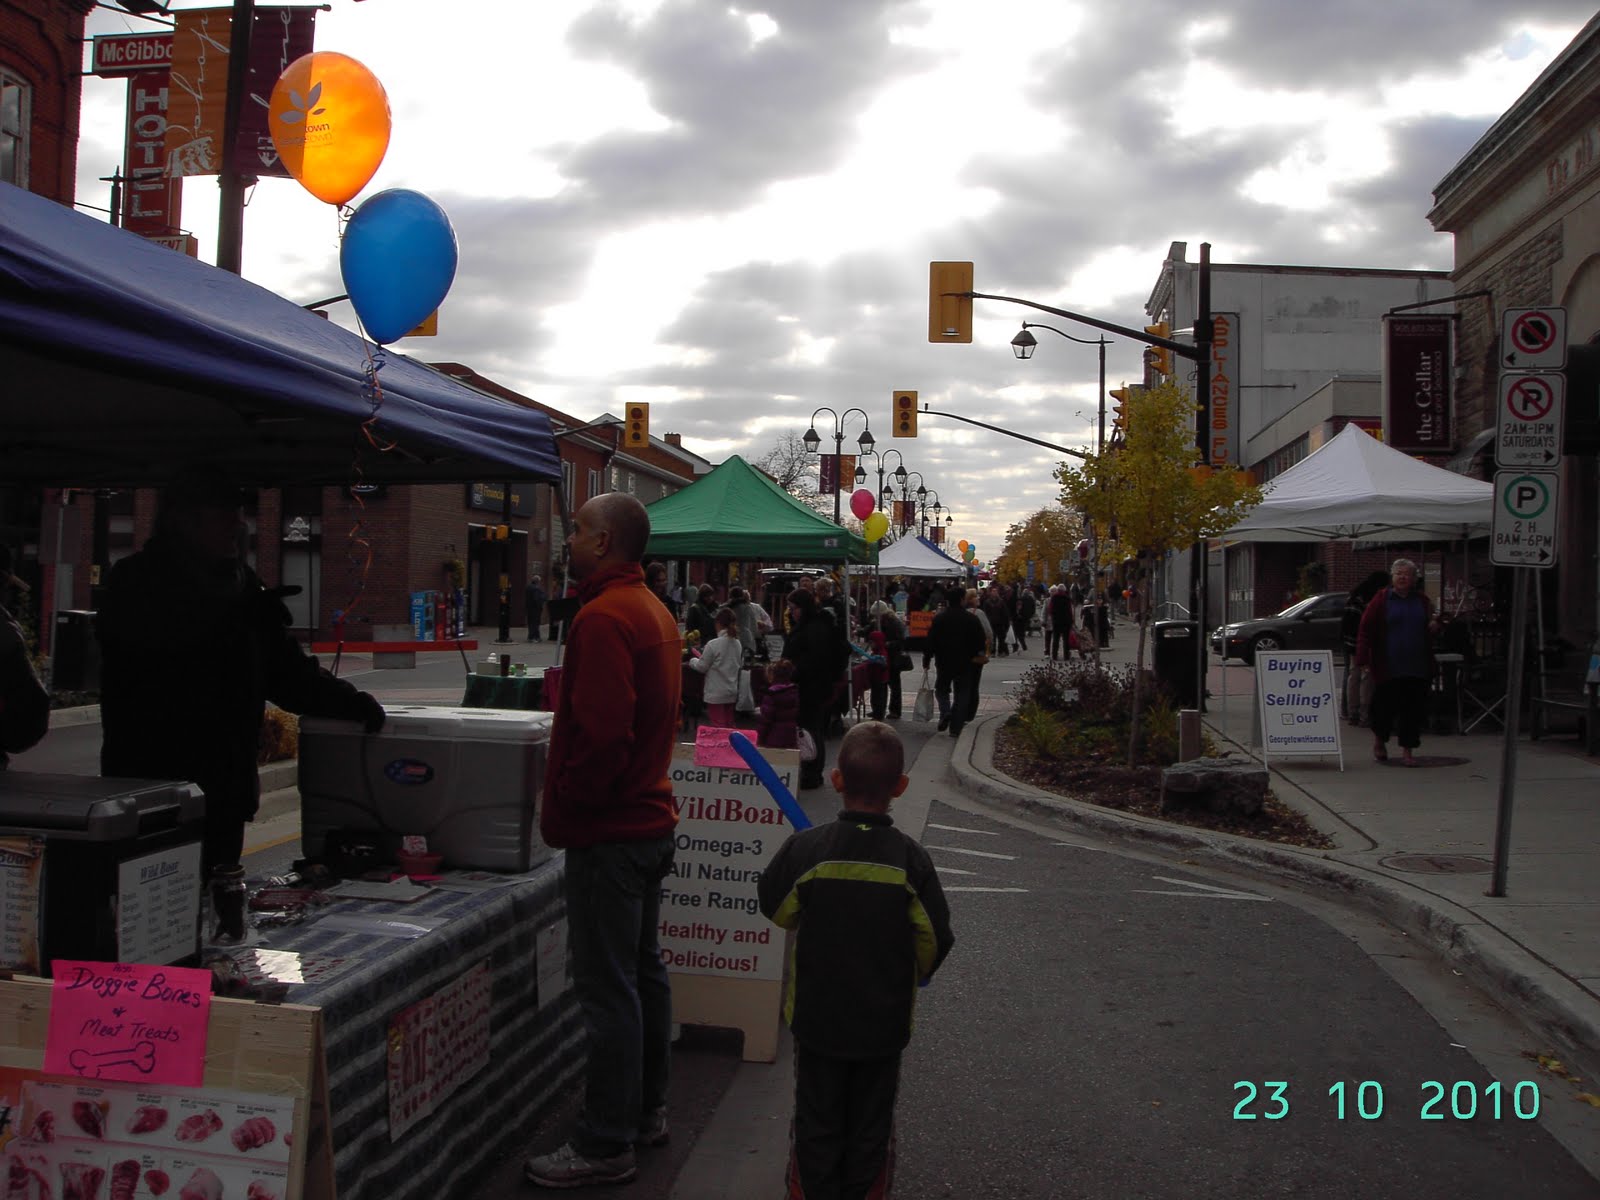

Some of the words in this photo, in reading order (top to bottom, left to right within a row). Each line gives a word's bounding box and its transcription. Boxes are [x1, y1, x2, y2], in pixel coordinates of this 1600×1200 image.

[131, 87, 169, 217] HOTEL
[1212, 315, 1230, 430] APPLIANCES
[1416, 351, 1431, 408] Cellar
[1416, 413, 1432, 441] the
[1504, 423, 1554, 435] 2AM-1PM
[1212, 437, 1228, 465] FU
[1502, 436, 1555, 447] SATURDAYS
[1517, 486, 1537, 508] P
[1514, 521, 1522, 533] 2
[1528, 521, 1537, 534] H
[1496, 533, 1553, 547] 8AM-6PM
[1268, 659, 1322, 674] Buying
[1288, 679, 1305, 688] or
[1266, 693, 1331, 708] Selling?
[1296, 715, 1318, 723] OUT
[669, 768, 712, 783] ocal
[718, 768, 791, 788] Farmd
[676, 834, 763, 858] Omega-3
[669, 862, 692, 879] All
[698, 864, 762, 883] Natura
[659, 889, 701, 907] Free
[708, 892, 760, 915] Rang
[733, 928, 770, 944] and
[661, 949, 758, 972] Delicious!
[66, 966, 138, 998] Doggie
[141, 973, 201, 1008] Bones
[80, 1018, 123, 1036] Meat
[131, 1022, 181, 1042] Treats
